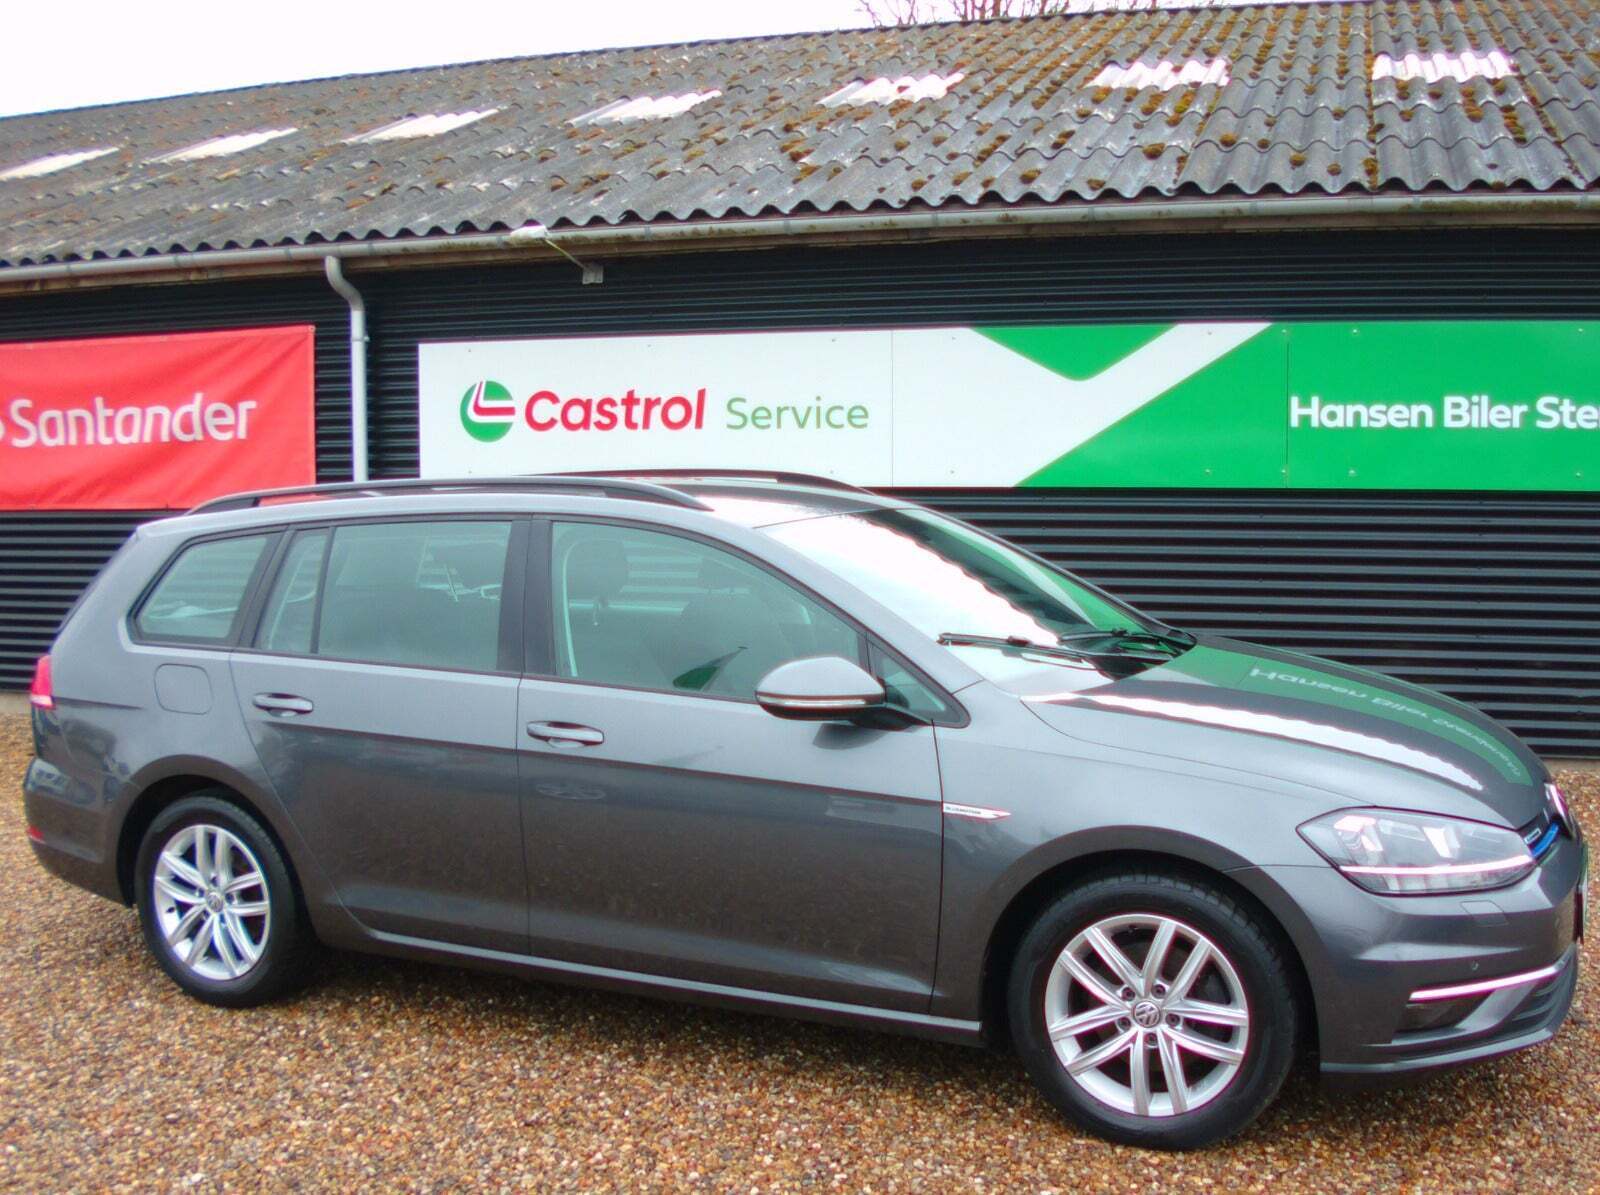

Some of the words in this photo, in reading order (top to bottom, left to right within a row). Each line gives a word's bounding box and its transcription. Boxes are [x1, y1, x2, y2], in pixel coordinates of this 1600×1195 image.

[10, 392, 258, 448] Santander
[524, 387, 707, 431] Castrol
[726, 396, 869, 431] Service
[1290, 396, 1434, 428] Hansen
[1444, 395, 1528, 428] Biler
[1535, 396, 1600, 429] Ste
